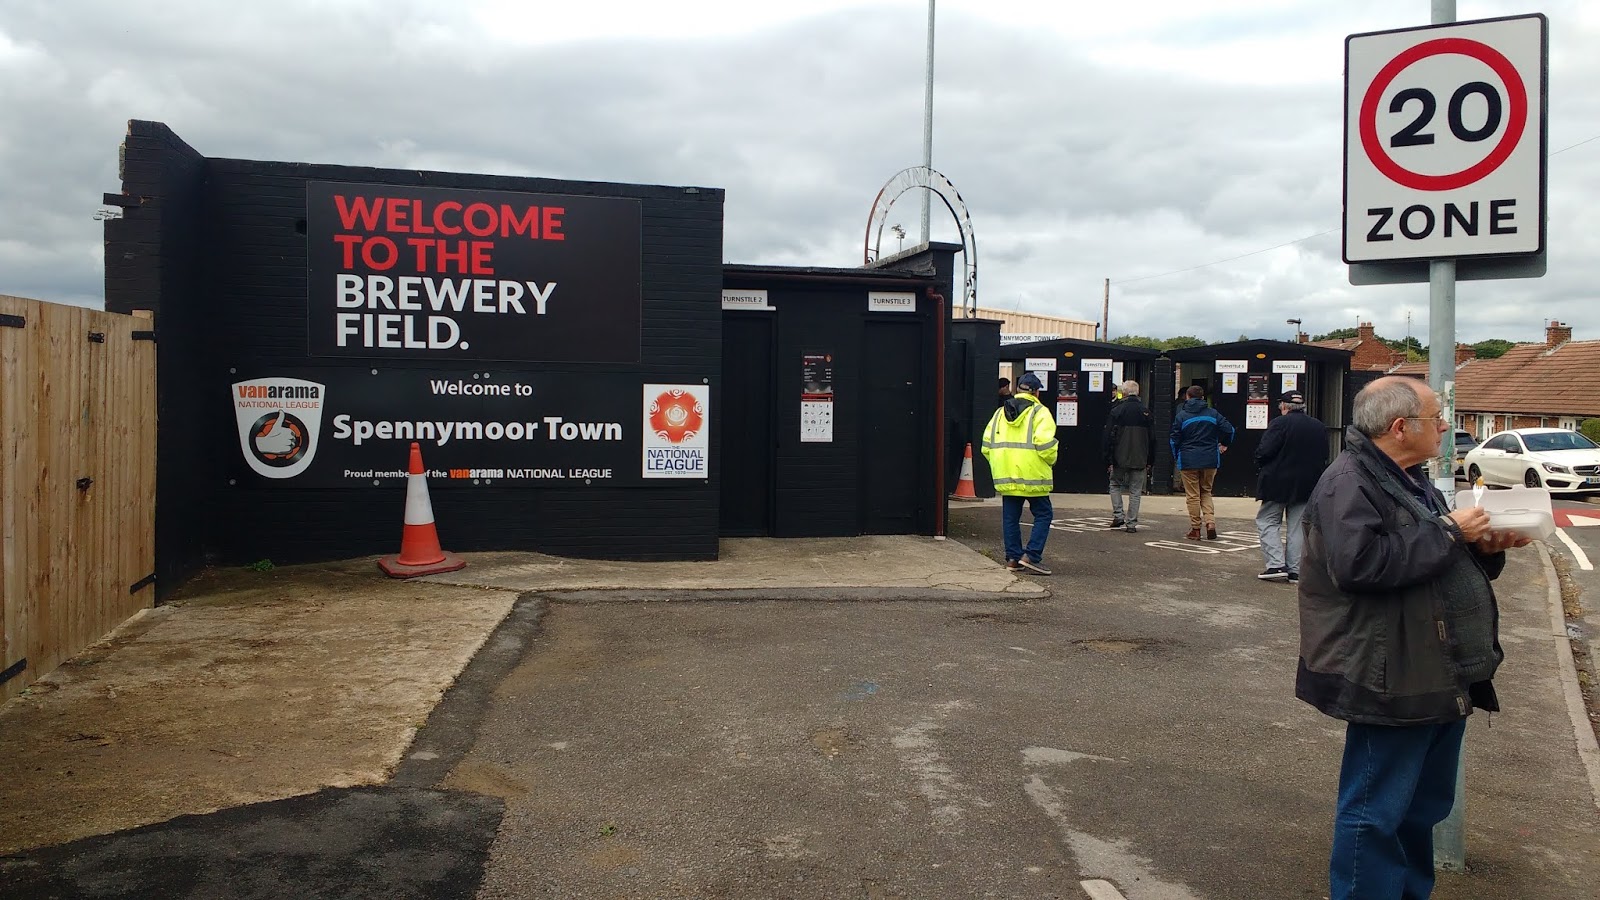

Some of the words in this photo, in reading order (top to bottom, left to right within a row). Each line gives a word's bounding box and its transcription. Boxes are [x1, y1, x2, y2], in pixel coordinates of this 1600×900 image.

[1389, 81, 1502, 148] 20
[334, 195, 565, 240] WELCOME
[1366, 198, 1518, 242] ZONE
[334, 234, 399, 270] TO
[407, 238, 495, 275] THE
[336, 274, 557, 315] BREWERY
[336, 312, 470, 350] FIELD.
[238, 385, 319, 399] vanarama
[430, 380, 511, 396] Welcome
[514, 382, 533, 396] to
[238, 401, 284, 409] NATIONAL
[285, 401, 320, 409] LEAGUE
[333, 414, 539, 446] Spennymoor
[543, 417, 623, 441] Town
[647, 449, 704, 458] NATIONAL
[647, 459, 704, 471] LEAGUE
[344, 469, 373, 478] Proud
[374, 469, 410, 478] membe
[431, 469, 448, 478] the
[450, 468, 503, 479] vanarama
[506, 468, 565, 479] NATIONAL
[569, 468, 612, 479] LEAGUE
